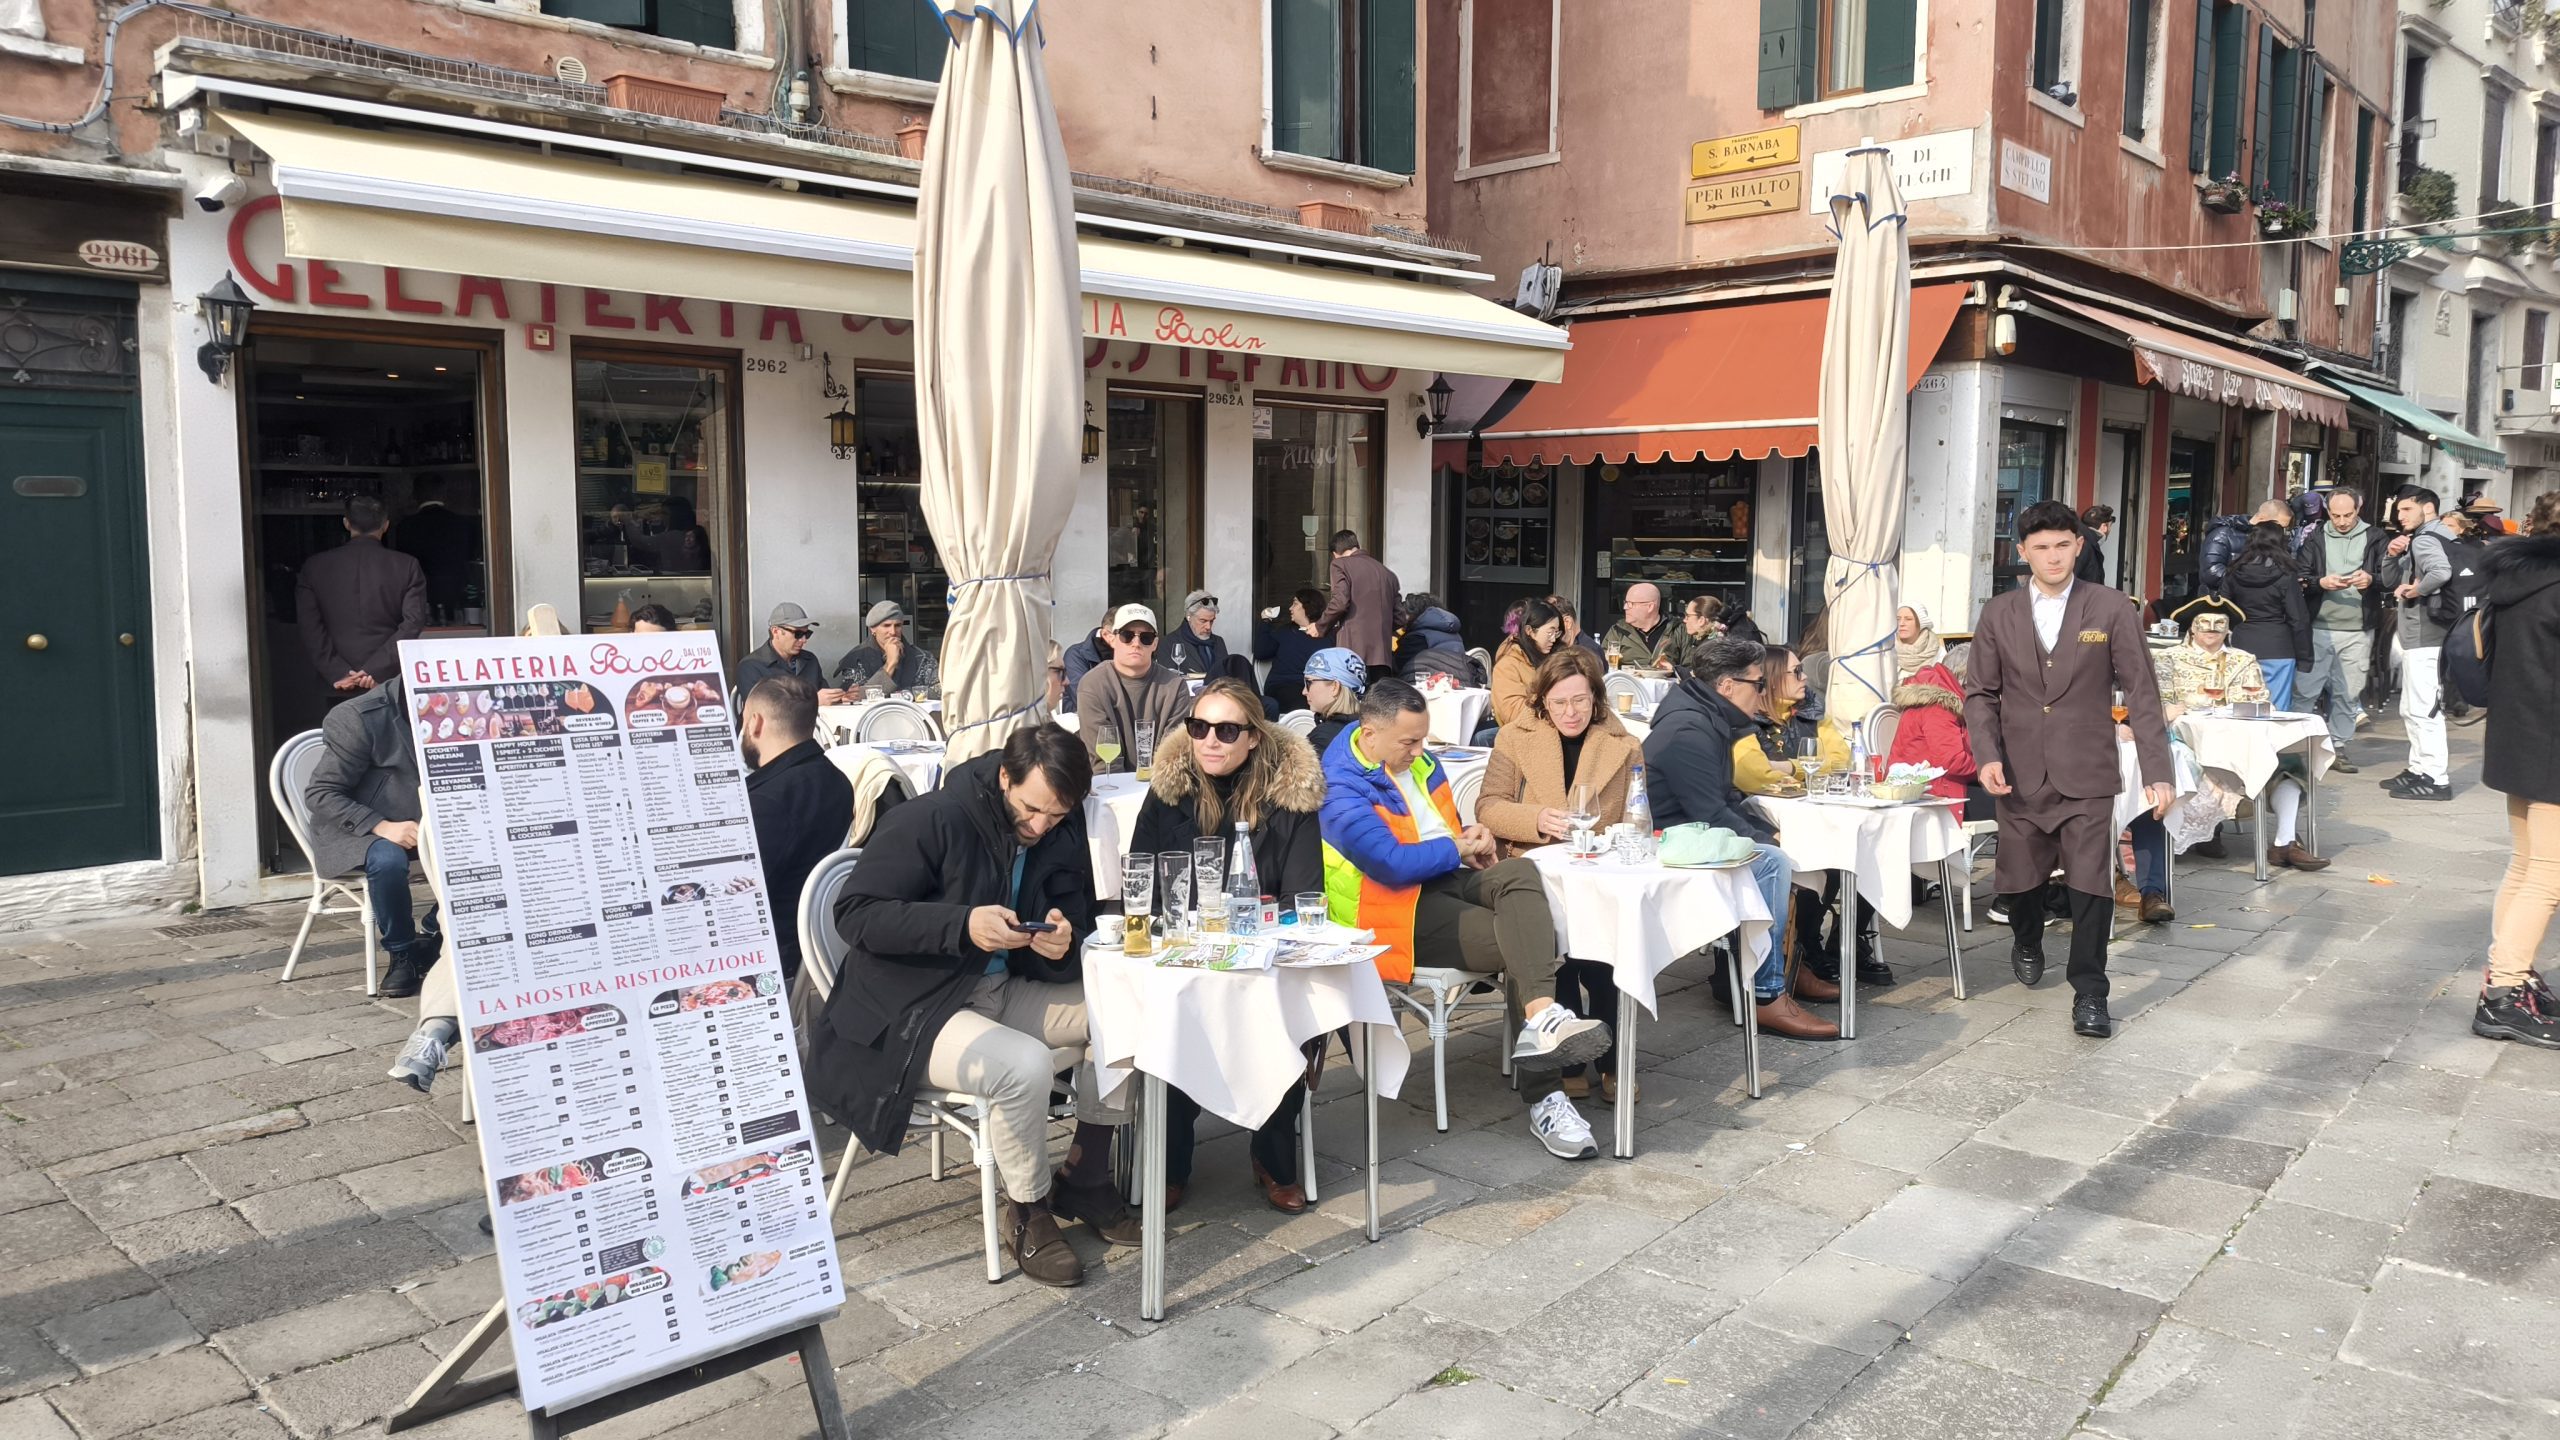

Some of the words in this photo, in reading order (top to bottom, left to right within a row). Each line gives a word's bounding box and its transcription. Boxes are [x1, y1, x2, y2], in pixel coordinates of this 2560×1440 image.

[1708, 148, 1719, 159] S.
[1724, 138, 1780, 157] BARNABA
[1695, 187, 1723, 203] PER
[1731, 178, 1790, 199] RIALTO
[86, 243, 148, 267] 2961
[1155, 306, 1266, 350] Paolin
[746, 357, 788, 374] 2962
[1208, 392, 1244, 406] 2962A
[697, 646, 712, 657] 1760
[414, 654, 578, 684] GELATERIA
[589, 643, 712, 675] Paolin
[517, 830, 551, 839] COCKTAILS
[529, 823, 554, 831] DRINKS
[470, 903, 495, 911] DRINKS
[527, 931, 546, 939] LONG
[548, 927, 572, 936] DRINKS
[478, 995, 507, 1015] LA
[514, 977, 608, 1008] NOSTRA
[614, 949, 766, 990] RISTORAZIONE
